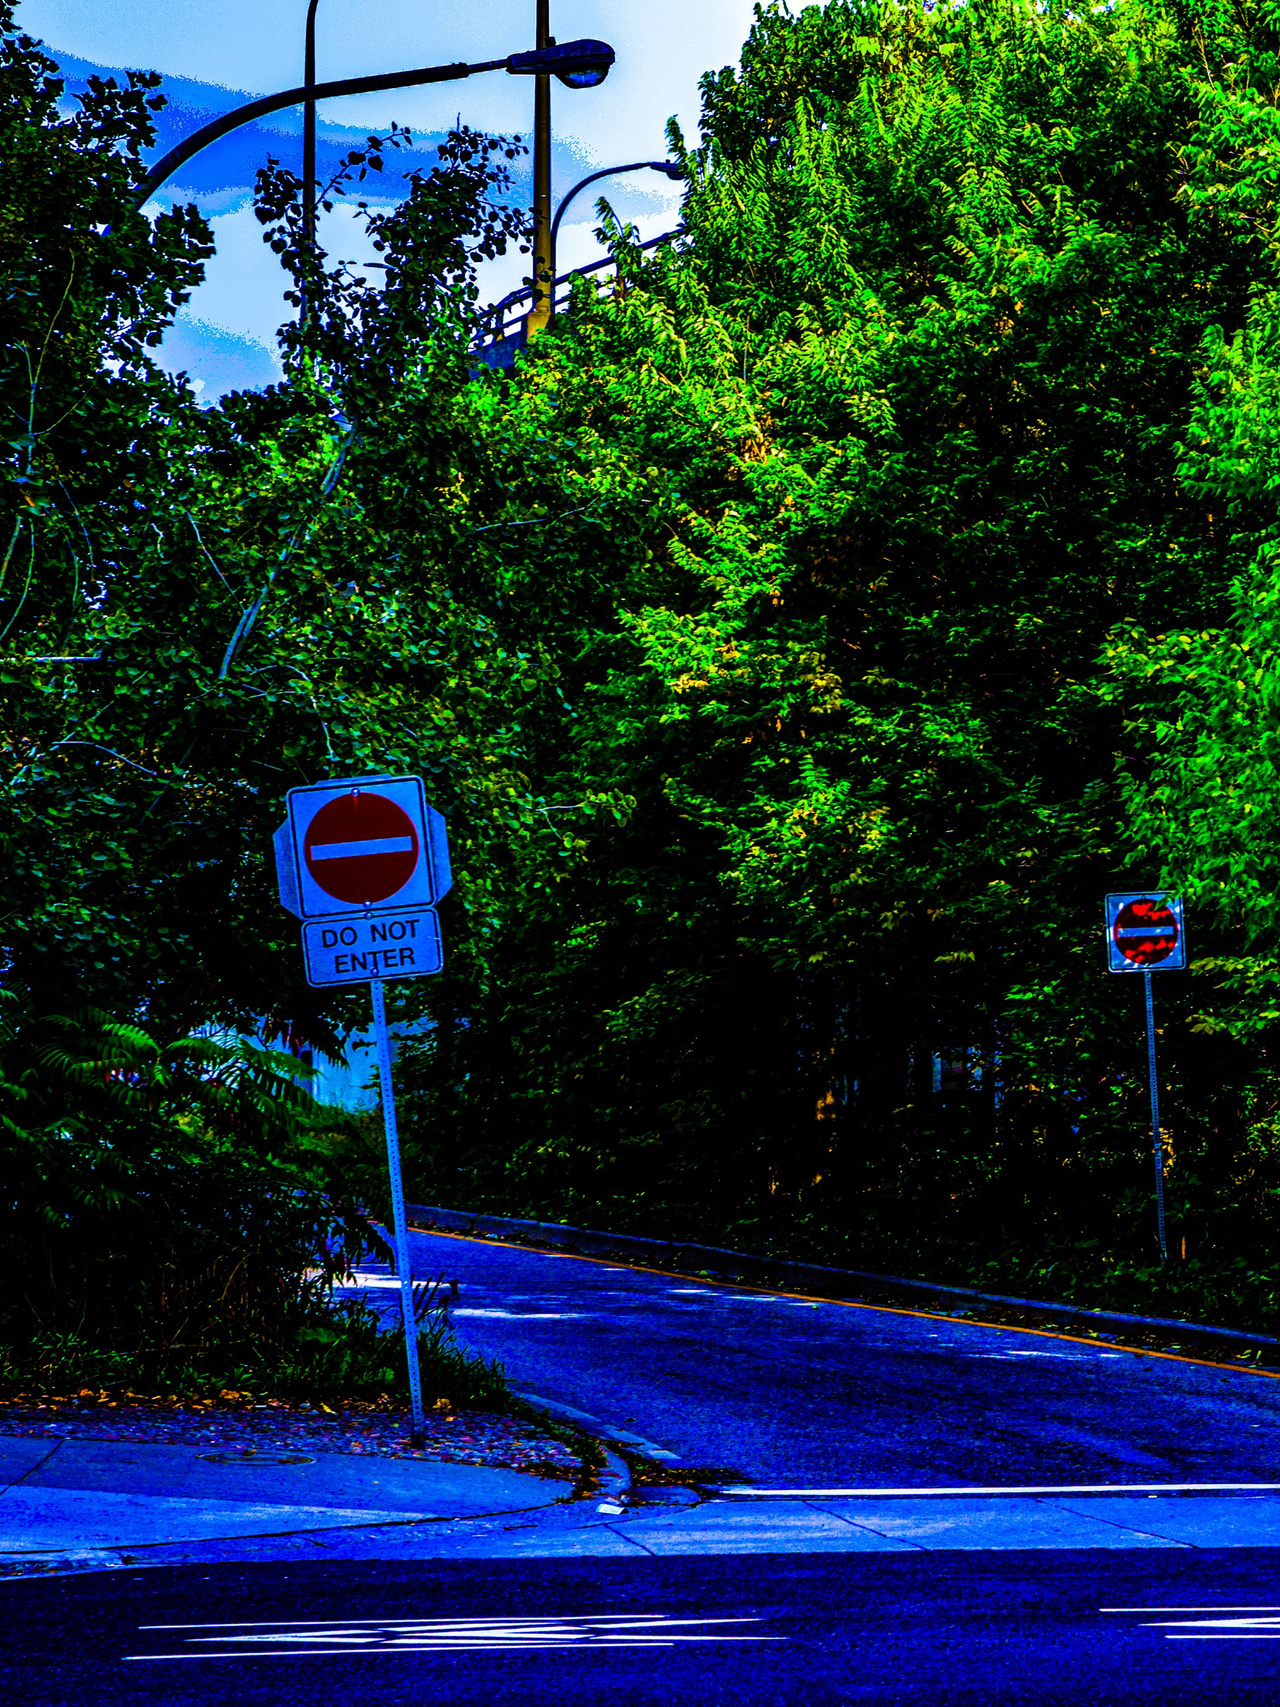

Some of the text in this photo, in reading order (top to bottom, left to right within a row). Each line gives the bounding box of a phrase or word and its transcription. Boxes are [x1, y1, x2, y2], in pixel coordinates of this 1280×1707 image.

[321, 919, 420, 949] DO NOT
[334, 947, 416, 974] ENTER
